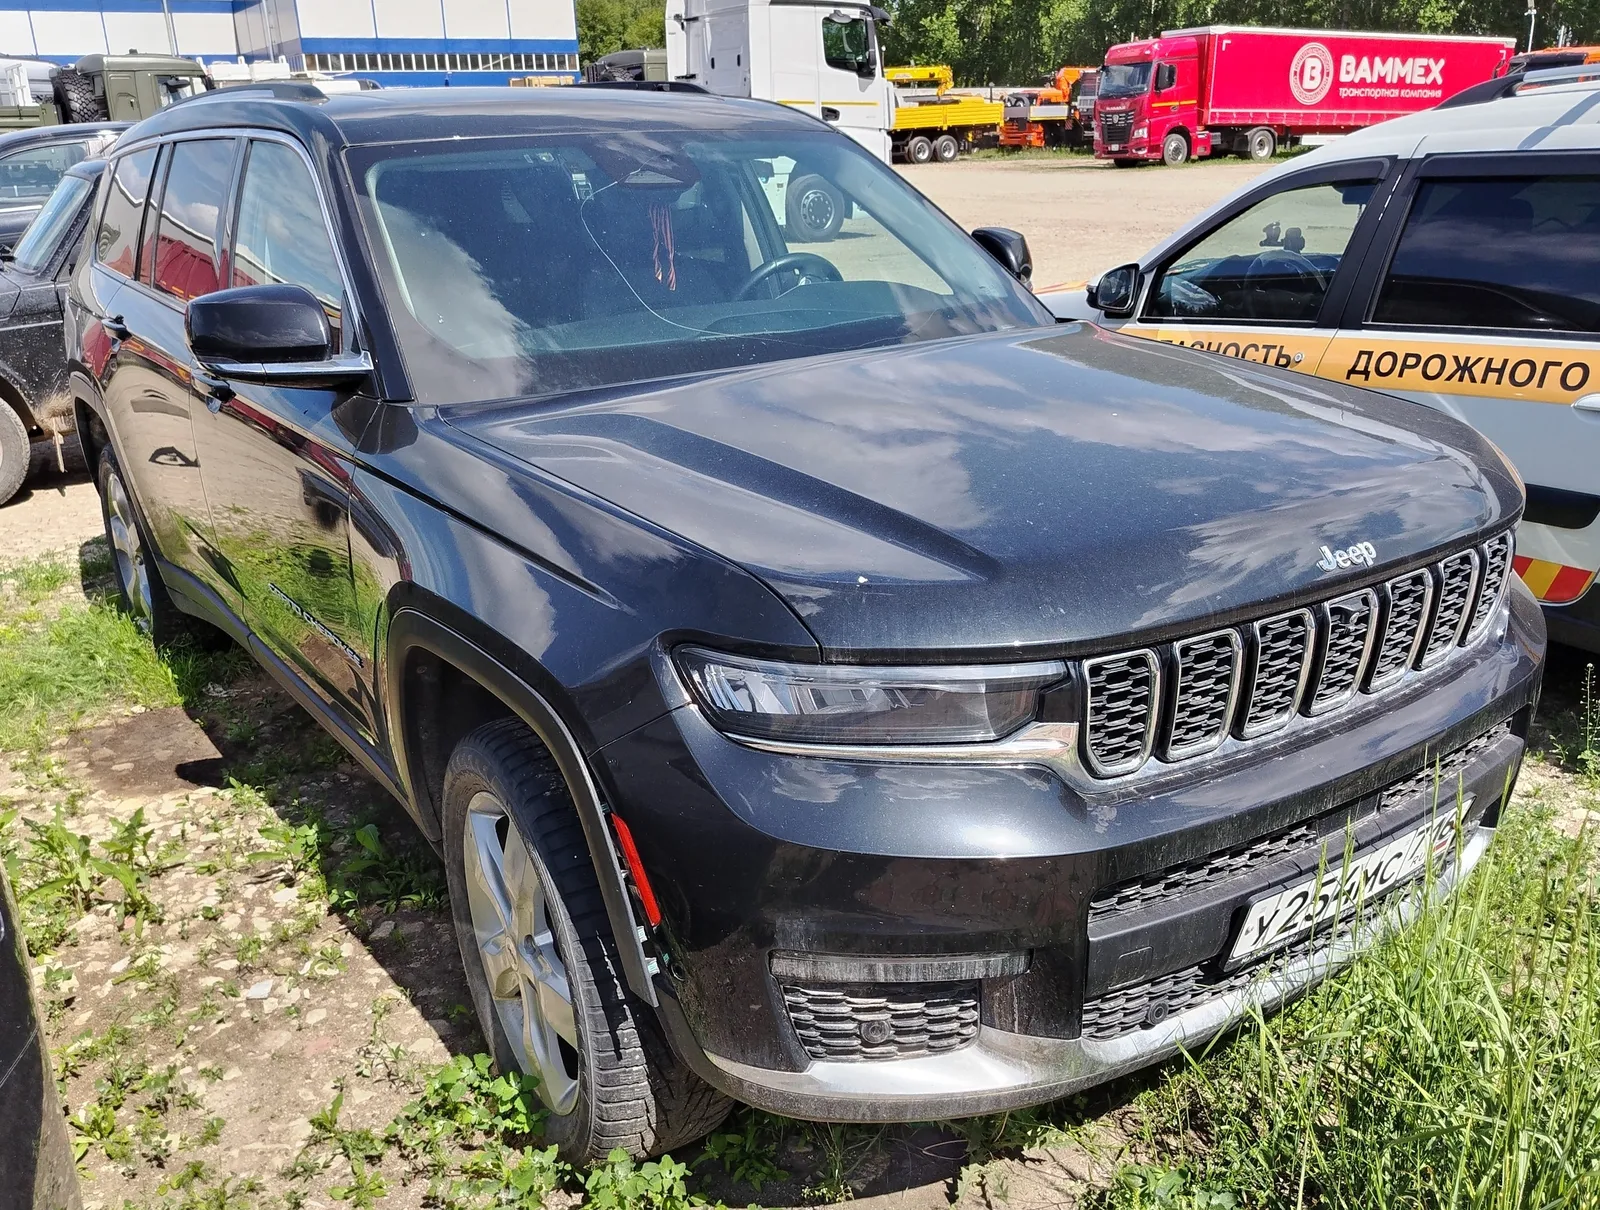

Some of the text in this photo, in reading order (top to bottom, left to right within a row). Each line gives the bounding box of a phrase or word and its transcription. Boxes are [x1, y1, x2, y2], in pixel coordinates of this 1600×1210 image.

[1339, 55, 1445, 85] BAMMEX
[1338, 87, 1442, 99] транспортная компания
[1160, 339, 1292, 369] НОСТЬ
[1345, 350, 1591, 392] ДОРОЖНОГО
[1316, 541, 1377, 572] Jeep
